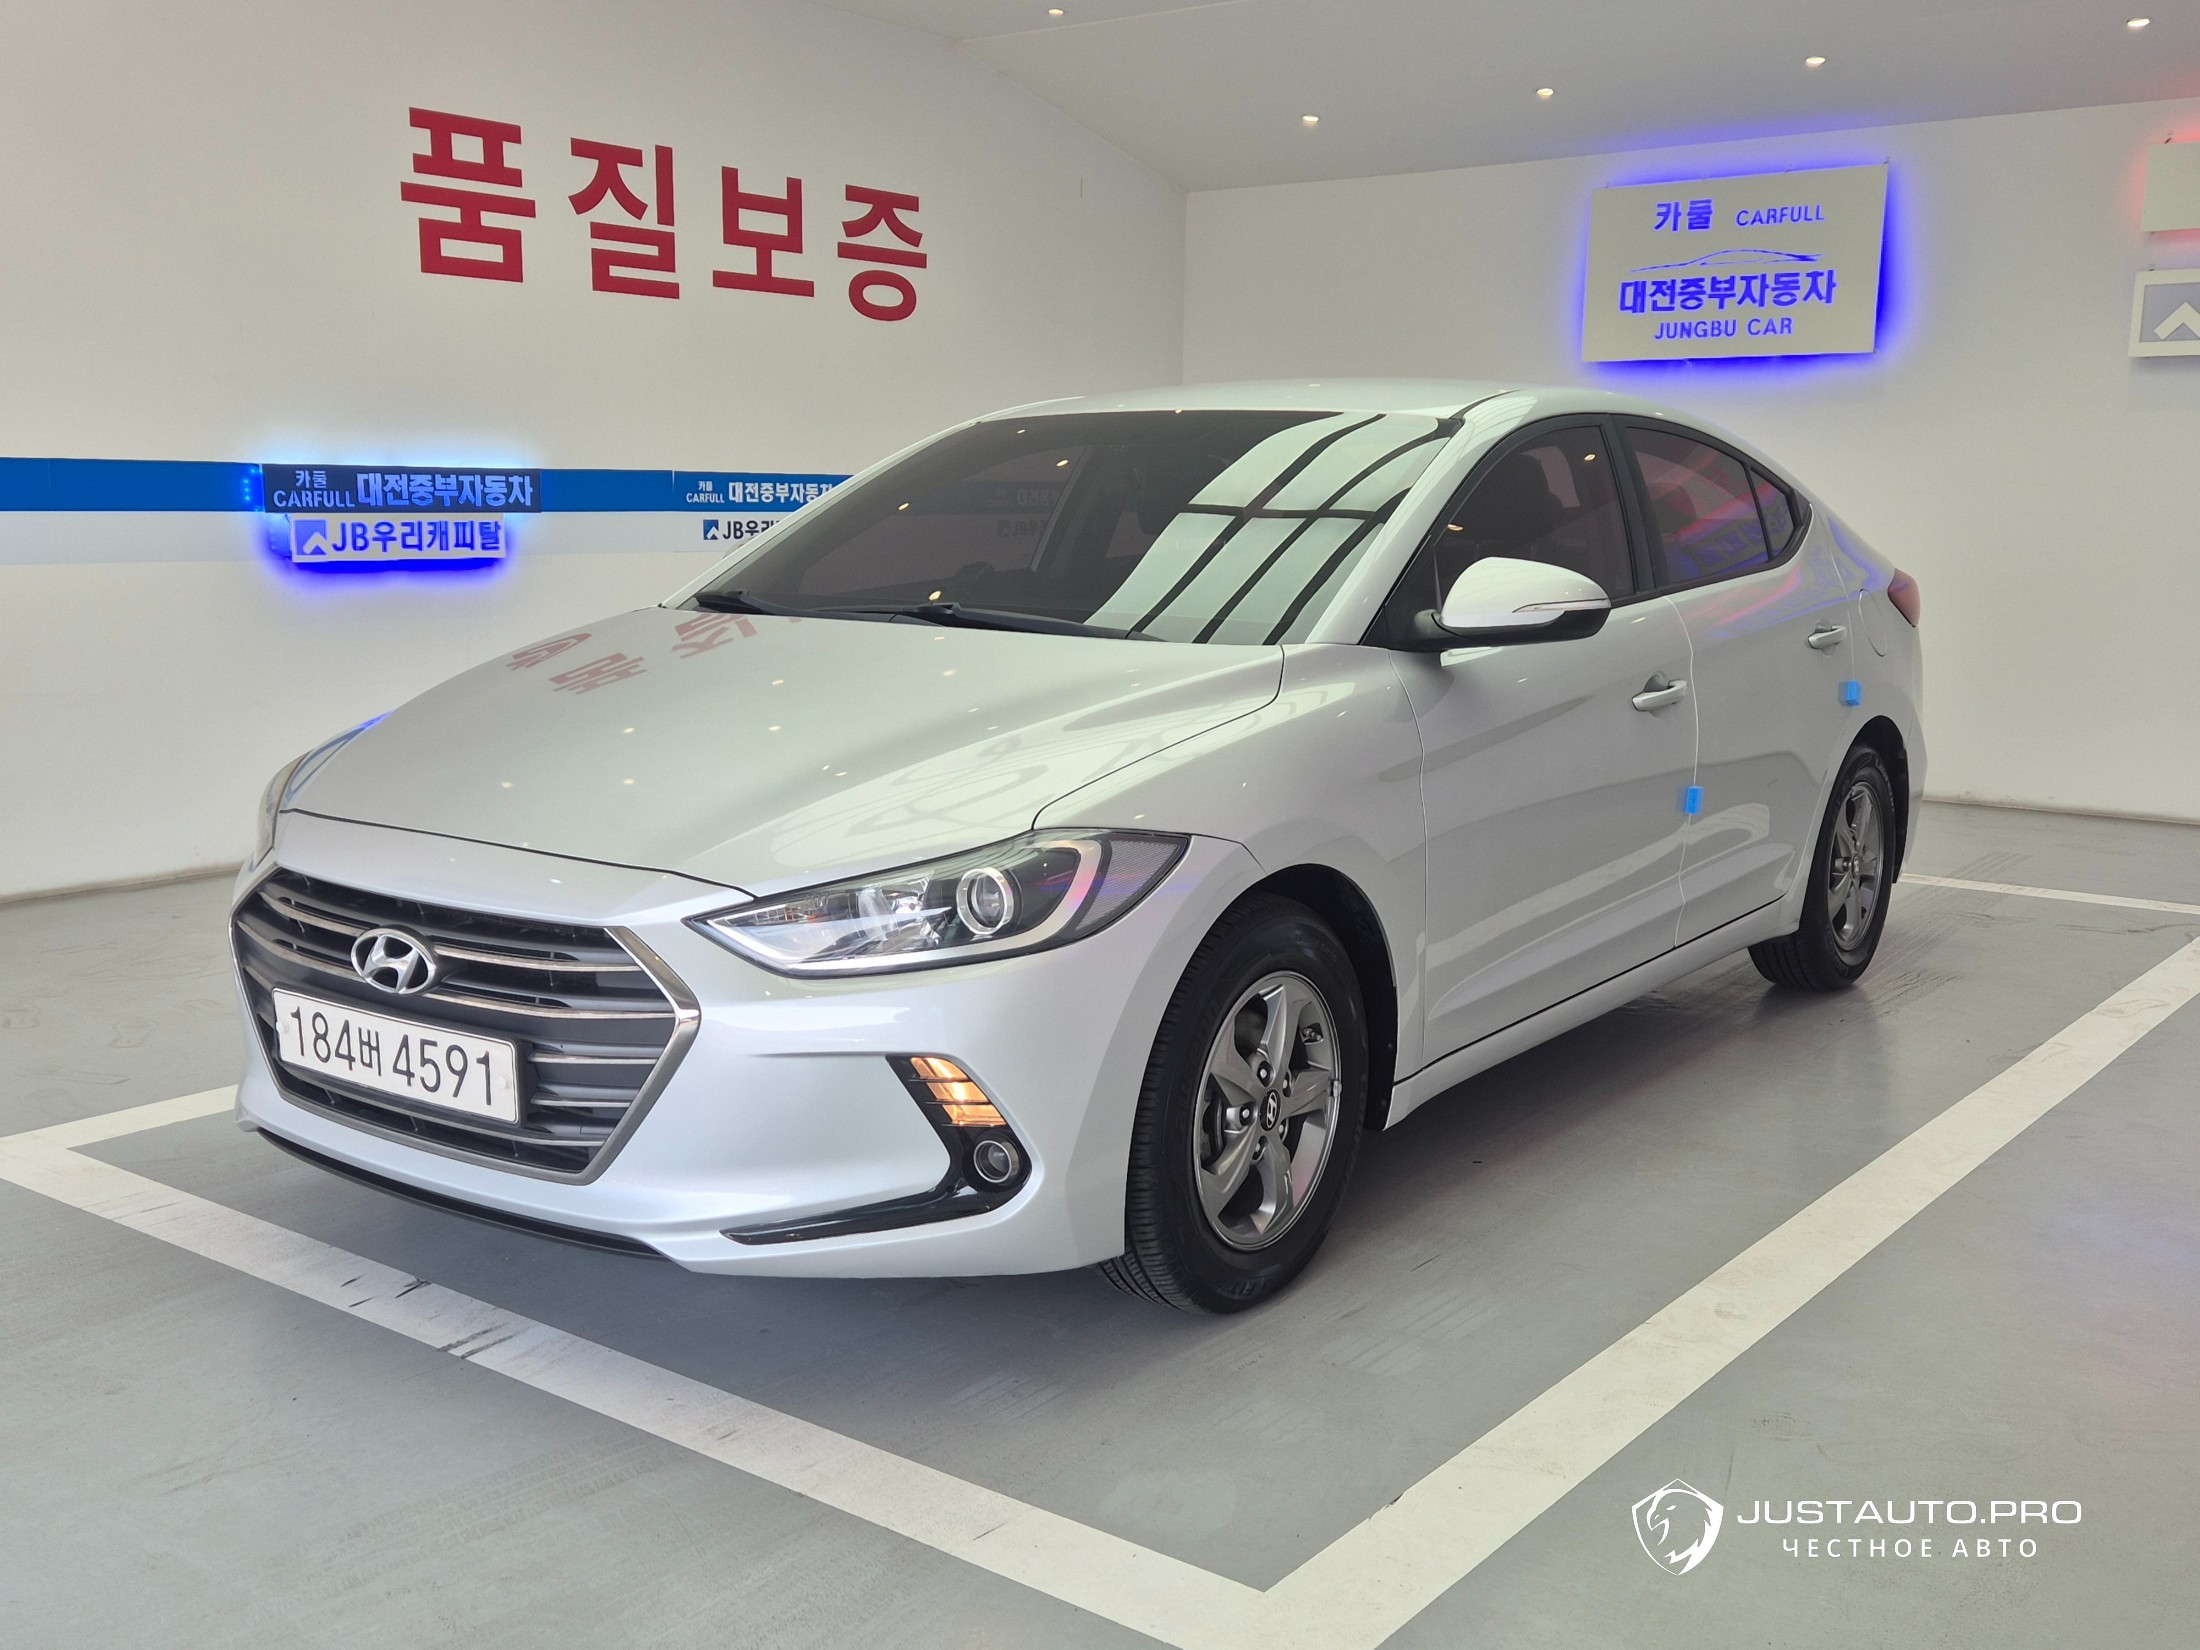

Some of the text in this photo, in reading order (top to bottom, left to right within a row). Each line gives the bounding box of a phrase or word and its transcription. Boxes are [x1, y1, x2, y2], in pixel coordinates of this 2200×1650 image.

[400, 106, 928, 322] 품질보증
[1735, 205, 1826, 226] CARFULL
[1619, 269, 1837, 314] 대전중부자동차
[1653, 317, 1793, 340] JUNGBU CAR
[273, 490, 356, 508] CARFULL
[356, 473, 533, 506] 대전중부자동차
[685, 492, 725, 504] CARFULL
[331, 520, 502, 552] JB우리캐피탈
[392, 1034, 492, 1106] 4591
